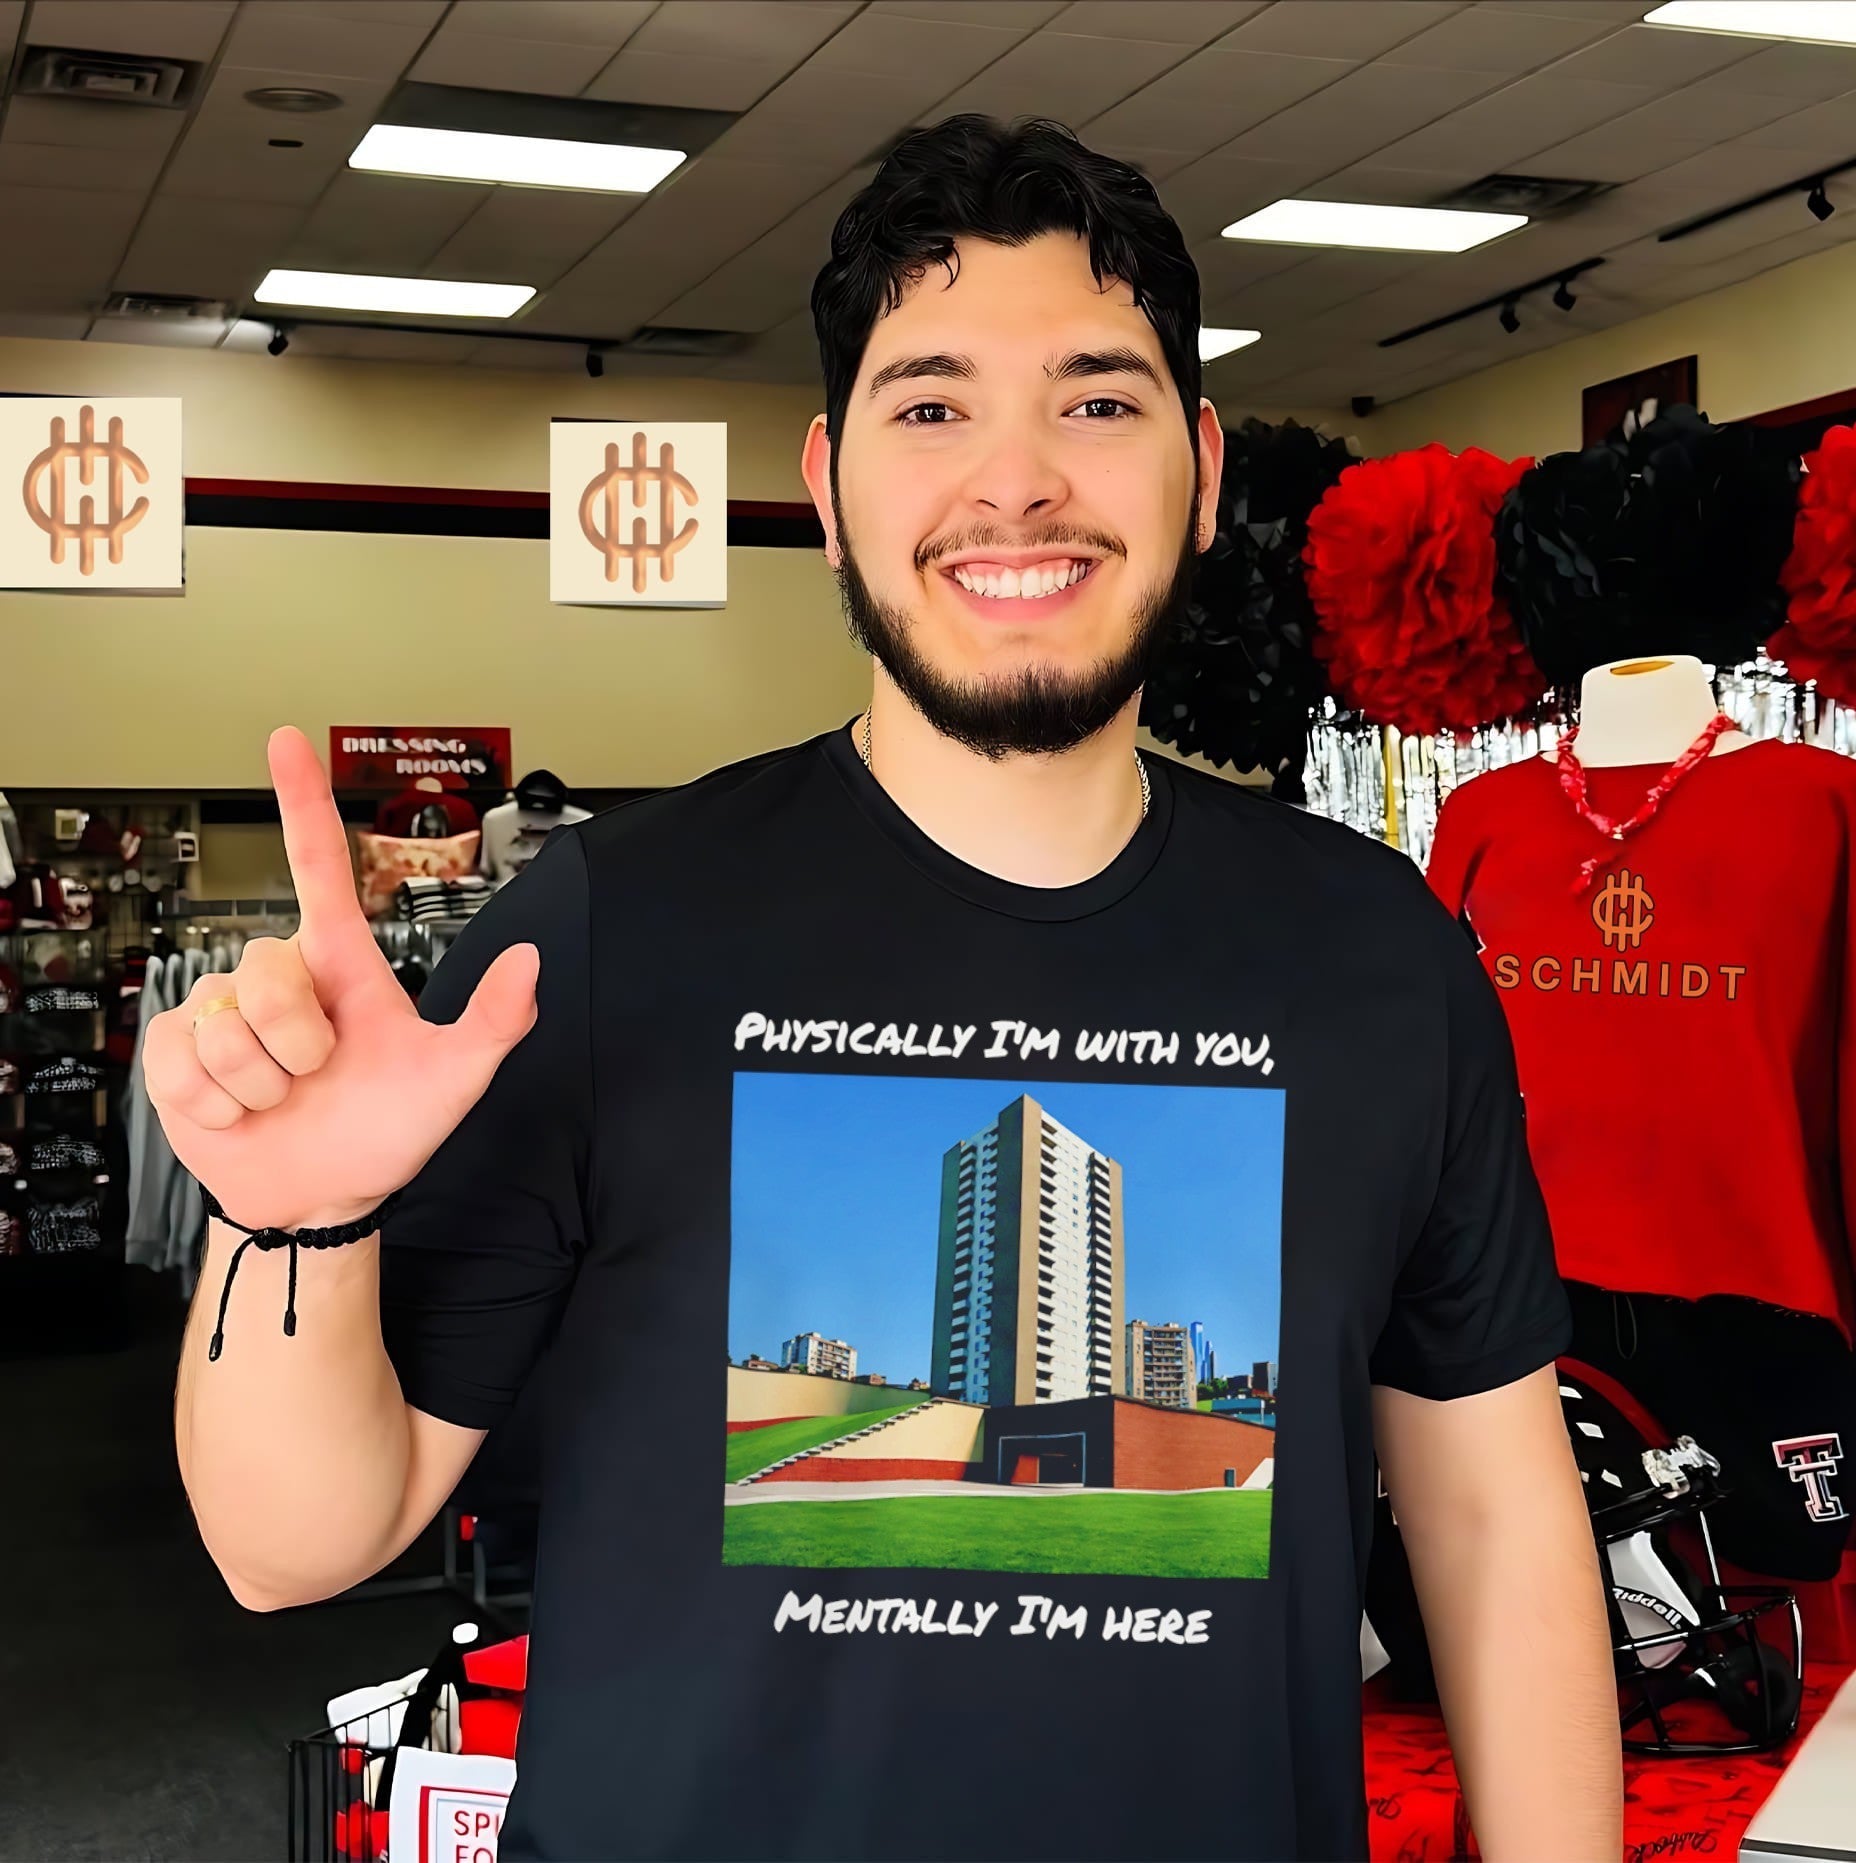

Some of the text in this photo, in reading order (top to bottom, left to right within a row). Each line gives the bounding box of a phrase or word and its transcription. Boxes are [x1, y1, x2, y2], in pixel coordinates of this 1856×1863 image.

[341, 737, 467, 754] DRESSING
[395, 758, 487, 775] ROOMS
[1494, 953, 1747, 1000] SCHMIDT
[984, 1021, 1060, 1060] I'M
[1010, 1596, 1087, 1639] I'M
